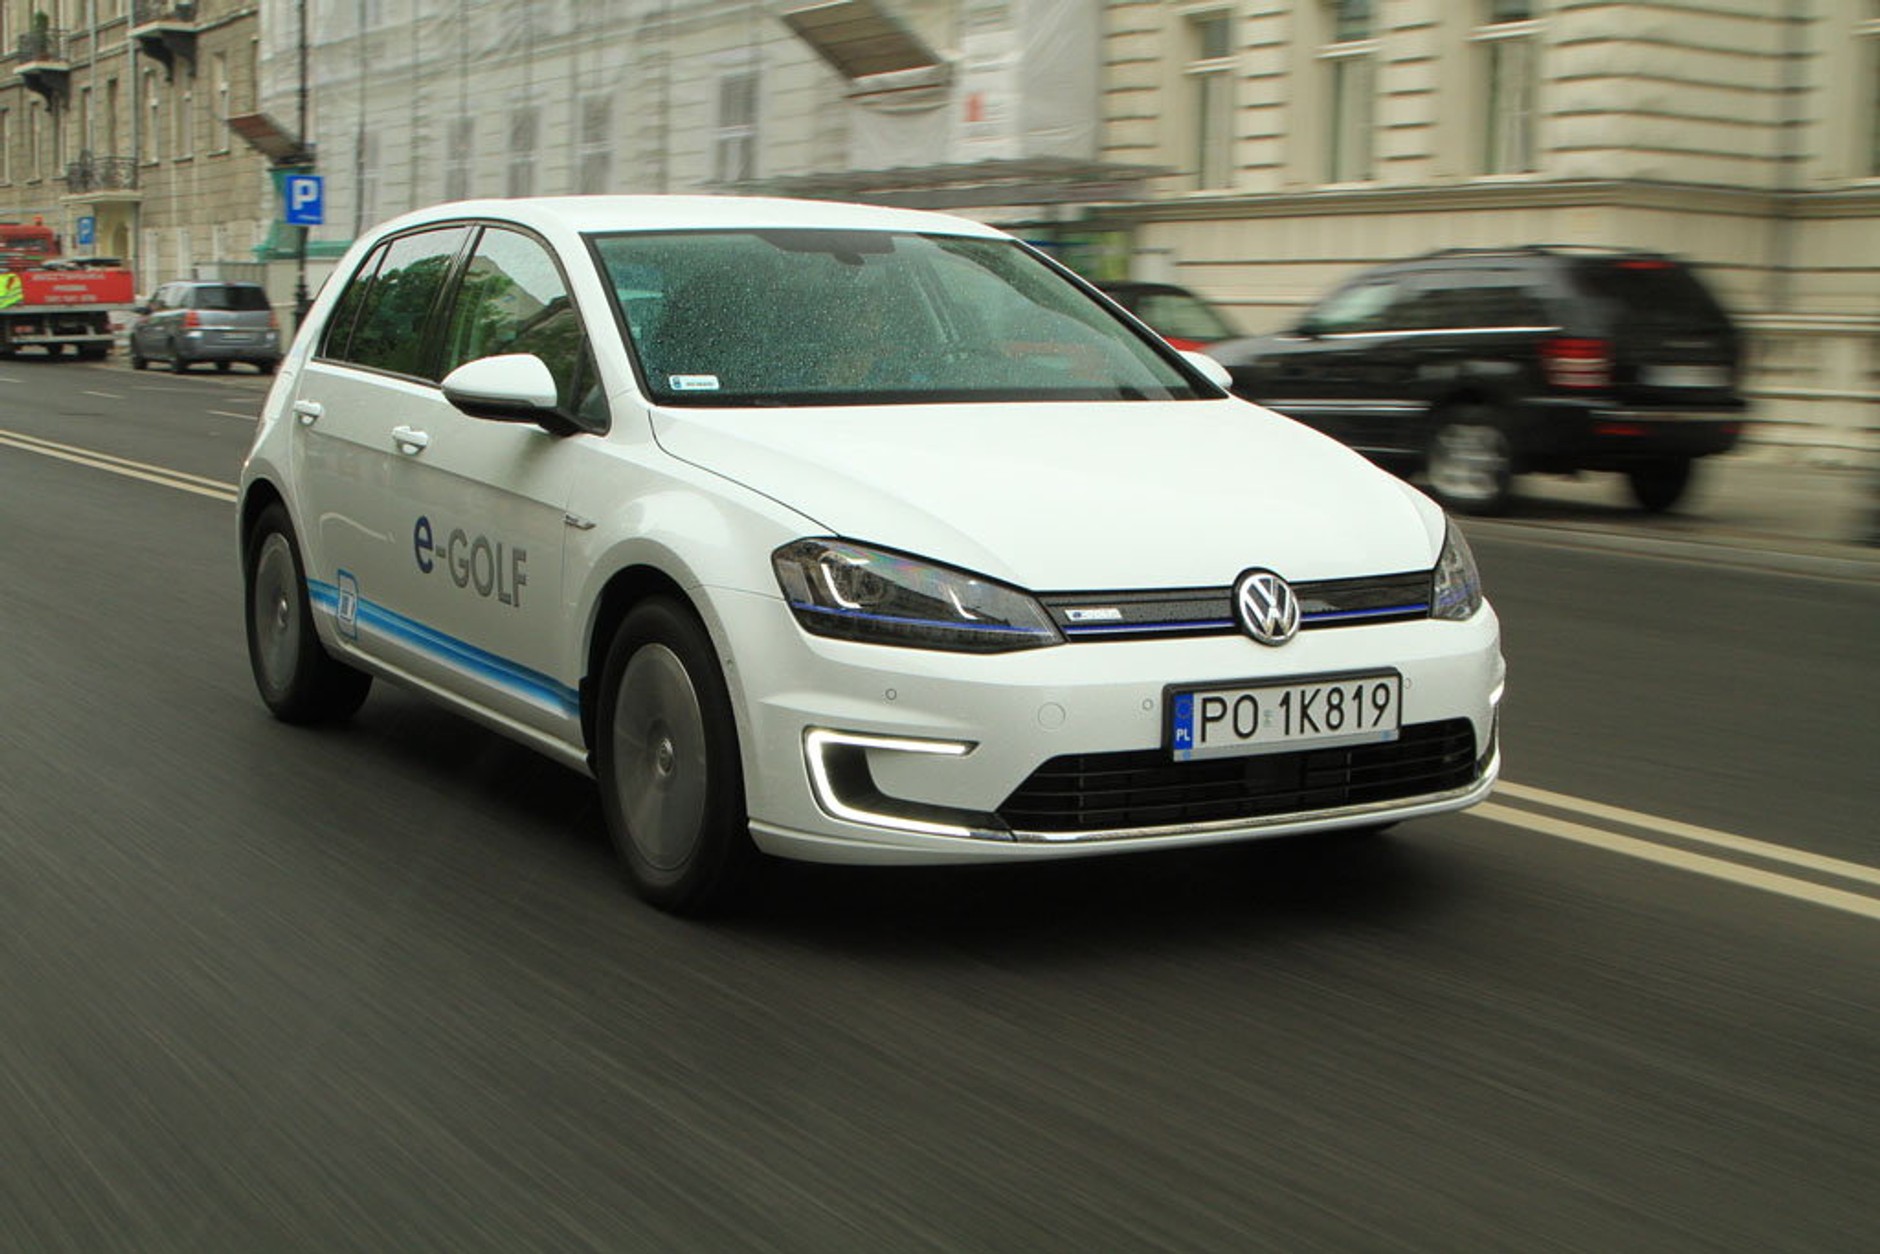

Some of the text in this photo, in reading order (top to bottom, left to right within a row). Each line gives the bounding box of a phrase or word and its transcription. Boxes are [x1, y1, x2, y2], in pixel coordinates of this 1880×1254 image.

[292, 179, 319, 210] P
[413, 515, 527, 608] e-GOLF
[1175, 728, 1191, 741] PL
[1201, 682, 1390, 742] PO 1K819
